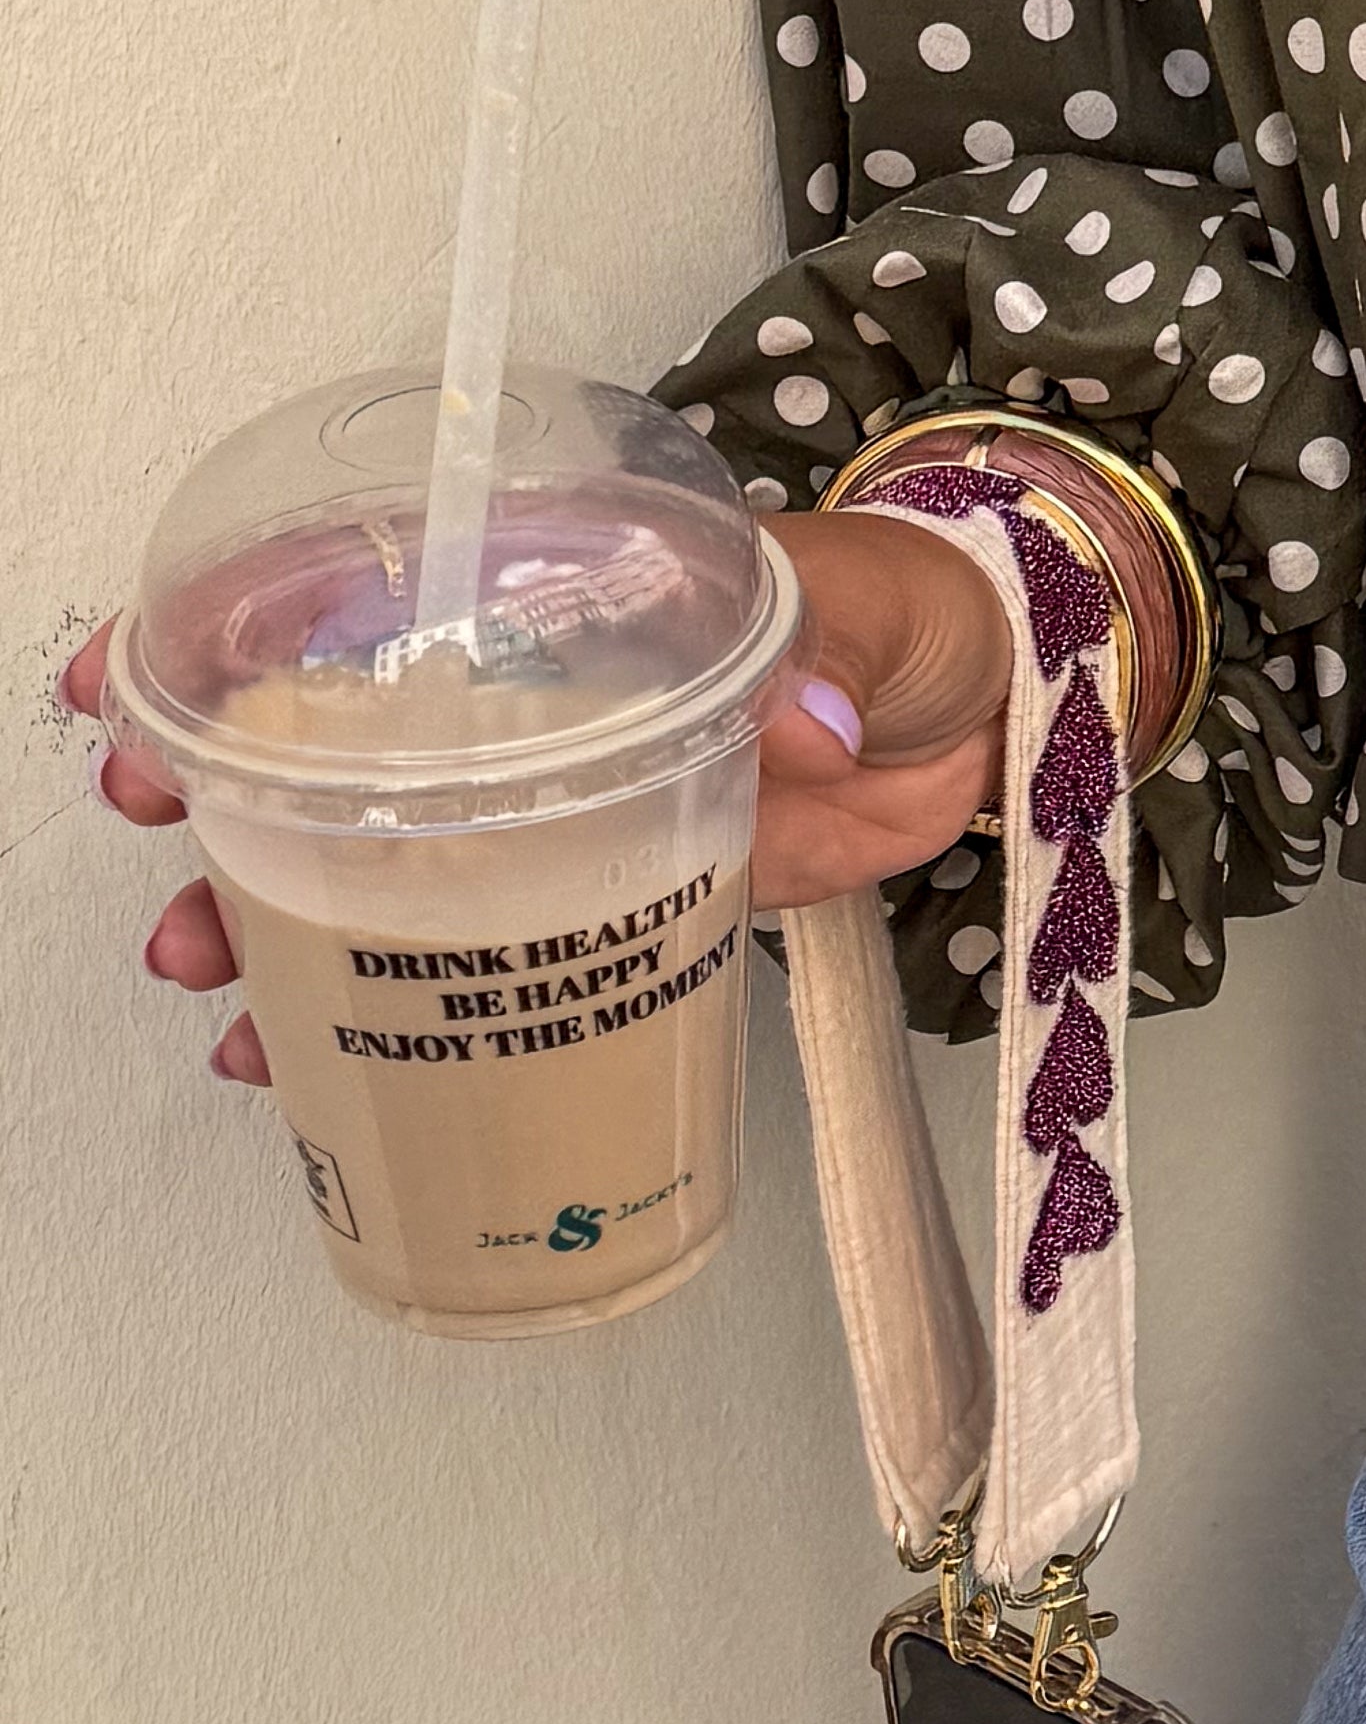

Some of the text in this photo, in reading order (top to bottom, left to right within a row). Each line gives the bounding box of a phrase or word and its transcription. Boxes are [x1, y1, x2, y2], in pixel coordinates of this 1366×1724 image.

[348, 862, 716, 980] DRINK HEALTHY
[332, 923, 738, 1062] ENJOY THE MOMENT
[439, 940, 664, 1020] BE HAPPY
[548, 1204, 607, 1252] &
